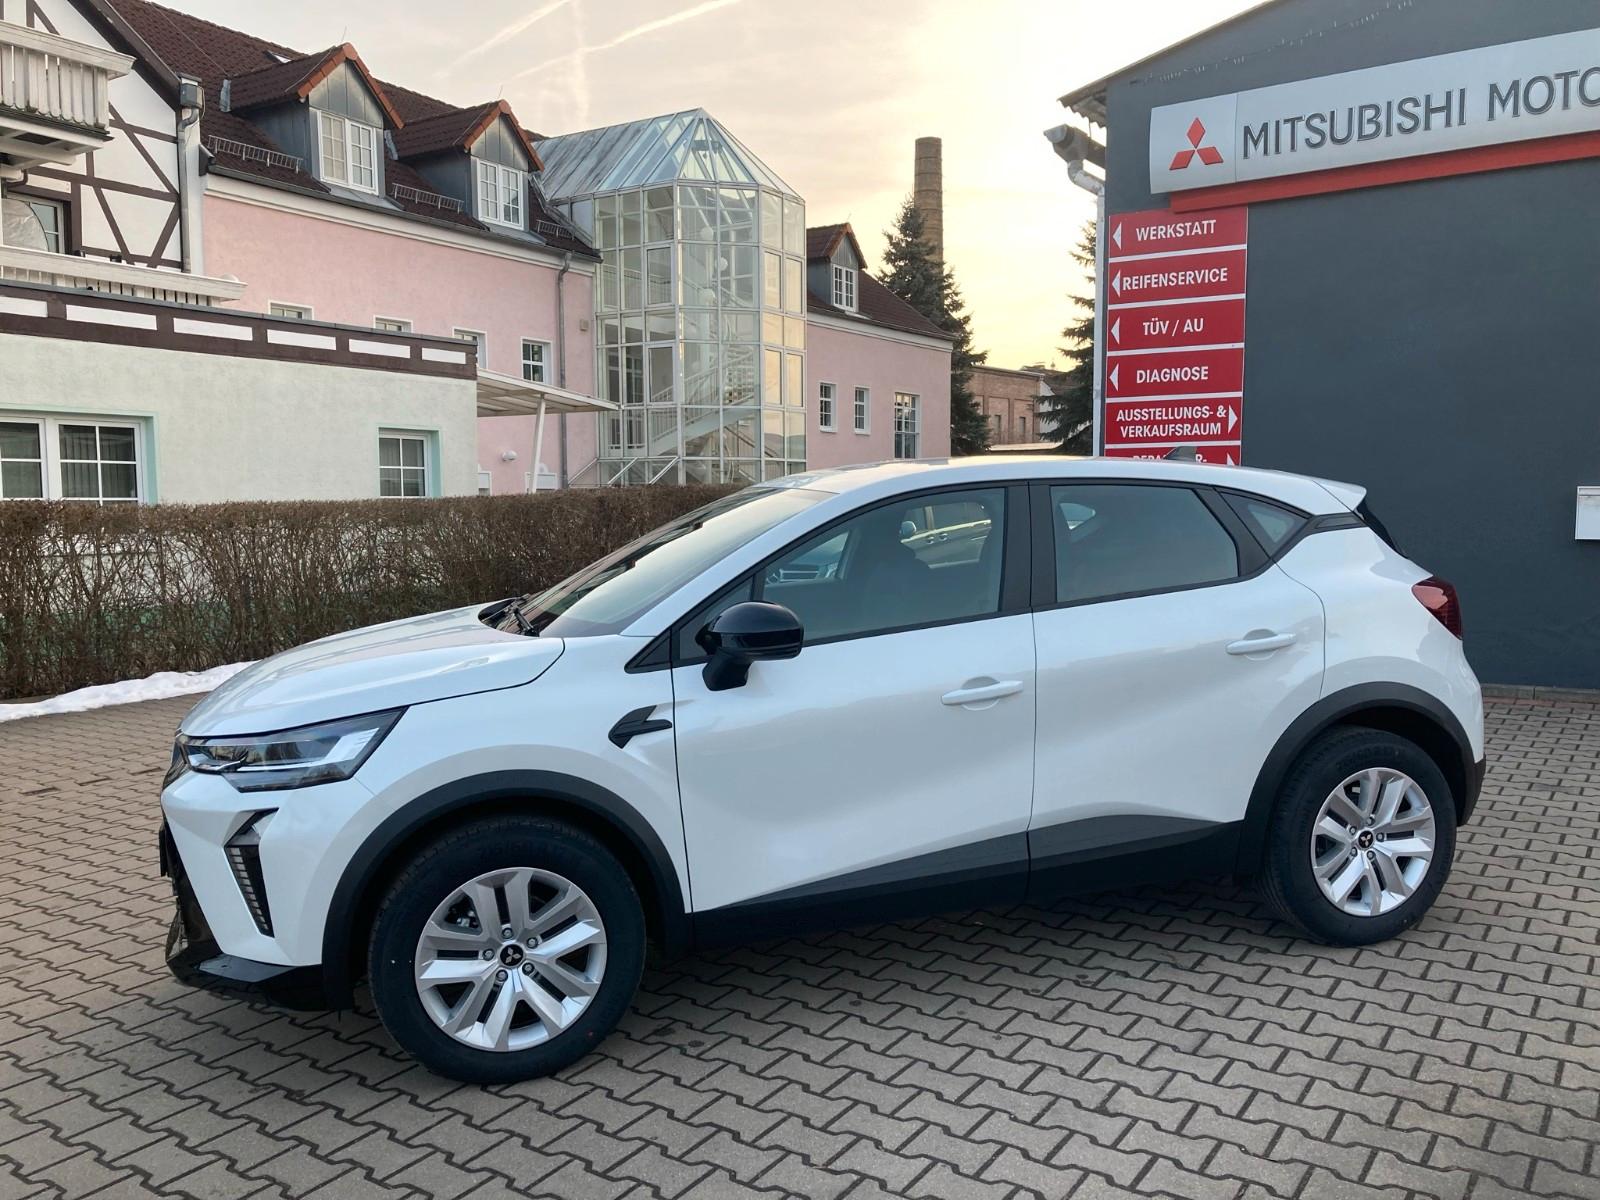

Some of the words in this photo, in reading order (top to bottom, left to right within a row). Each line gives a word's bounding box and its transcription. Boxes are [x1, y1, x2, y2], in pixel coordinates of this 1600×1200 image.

[1242, 88, 1467, 160] MITSUBISHI
[1487, 66, 1600, 121] MOTO
[1136, 219, 1217, 242] WERKSTATT
[1122, 268, 1228, 291] REIFENSERVICE
[1143, 318, 1169, 336] TÜV
[1172, 319, 1180, 337] /
[1183, 318, 1204, 334] AU
[1136, 366, 1209, 384] DIAGNOSE
[1116, 406, 1213, 422] AUSSTELLUNGS-
[1217, 405, 1227, 418] &
[1120, 423, 1222, 438] VERKAUFSRAUM
